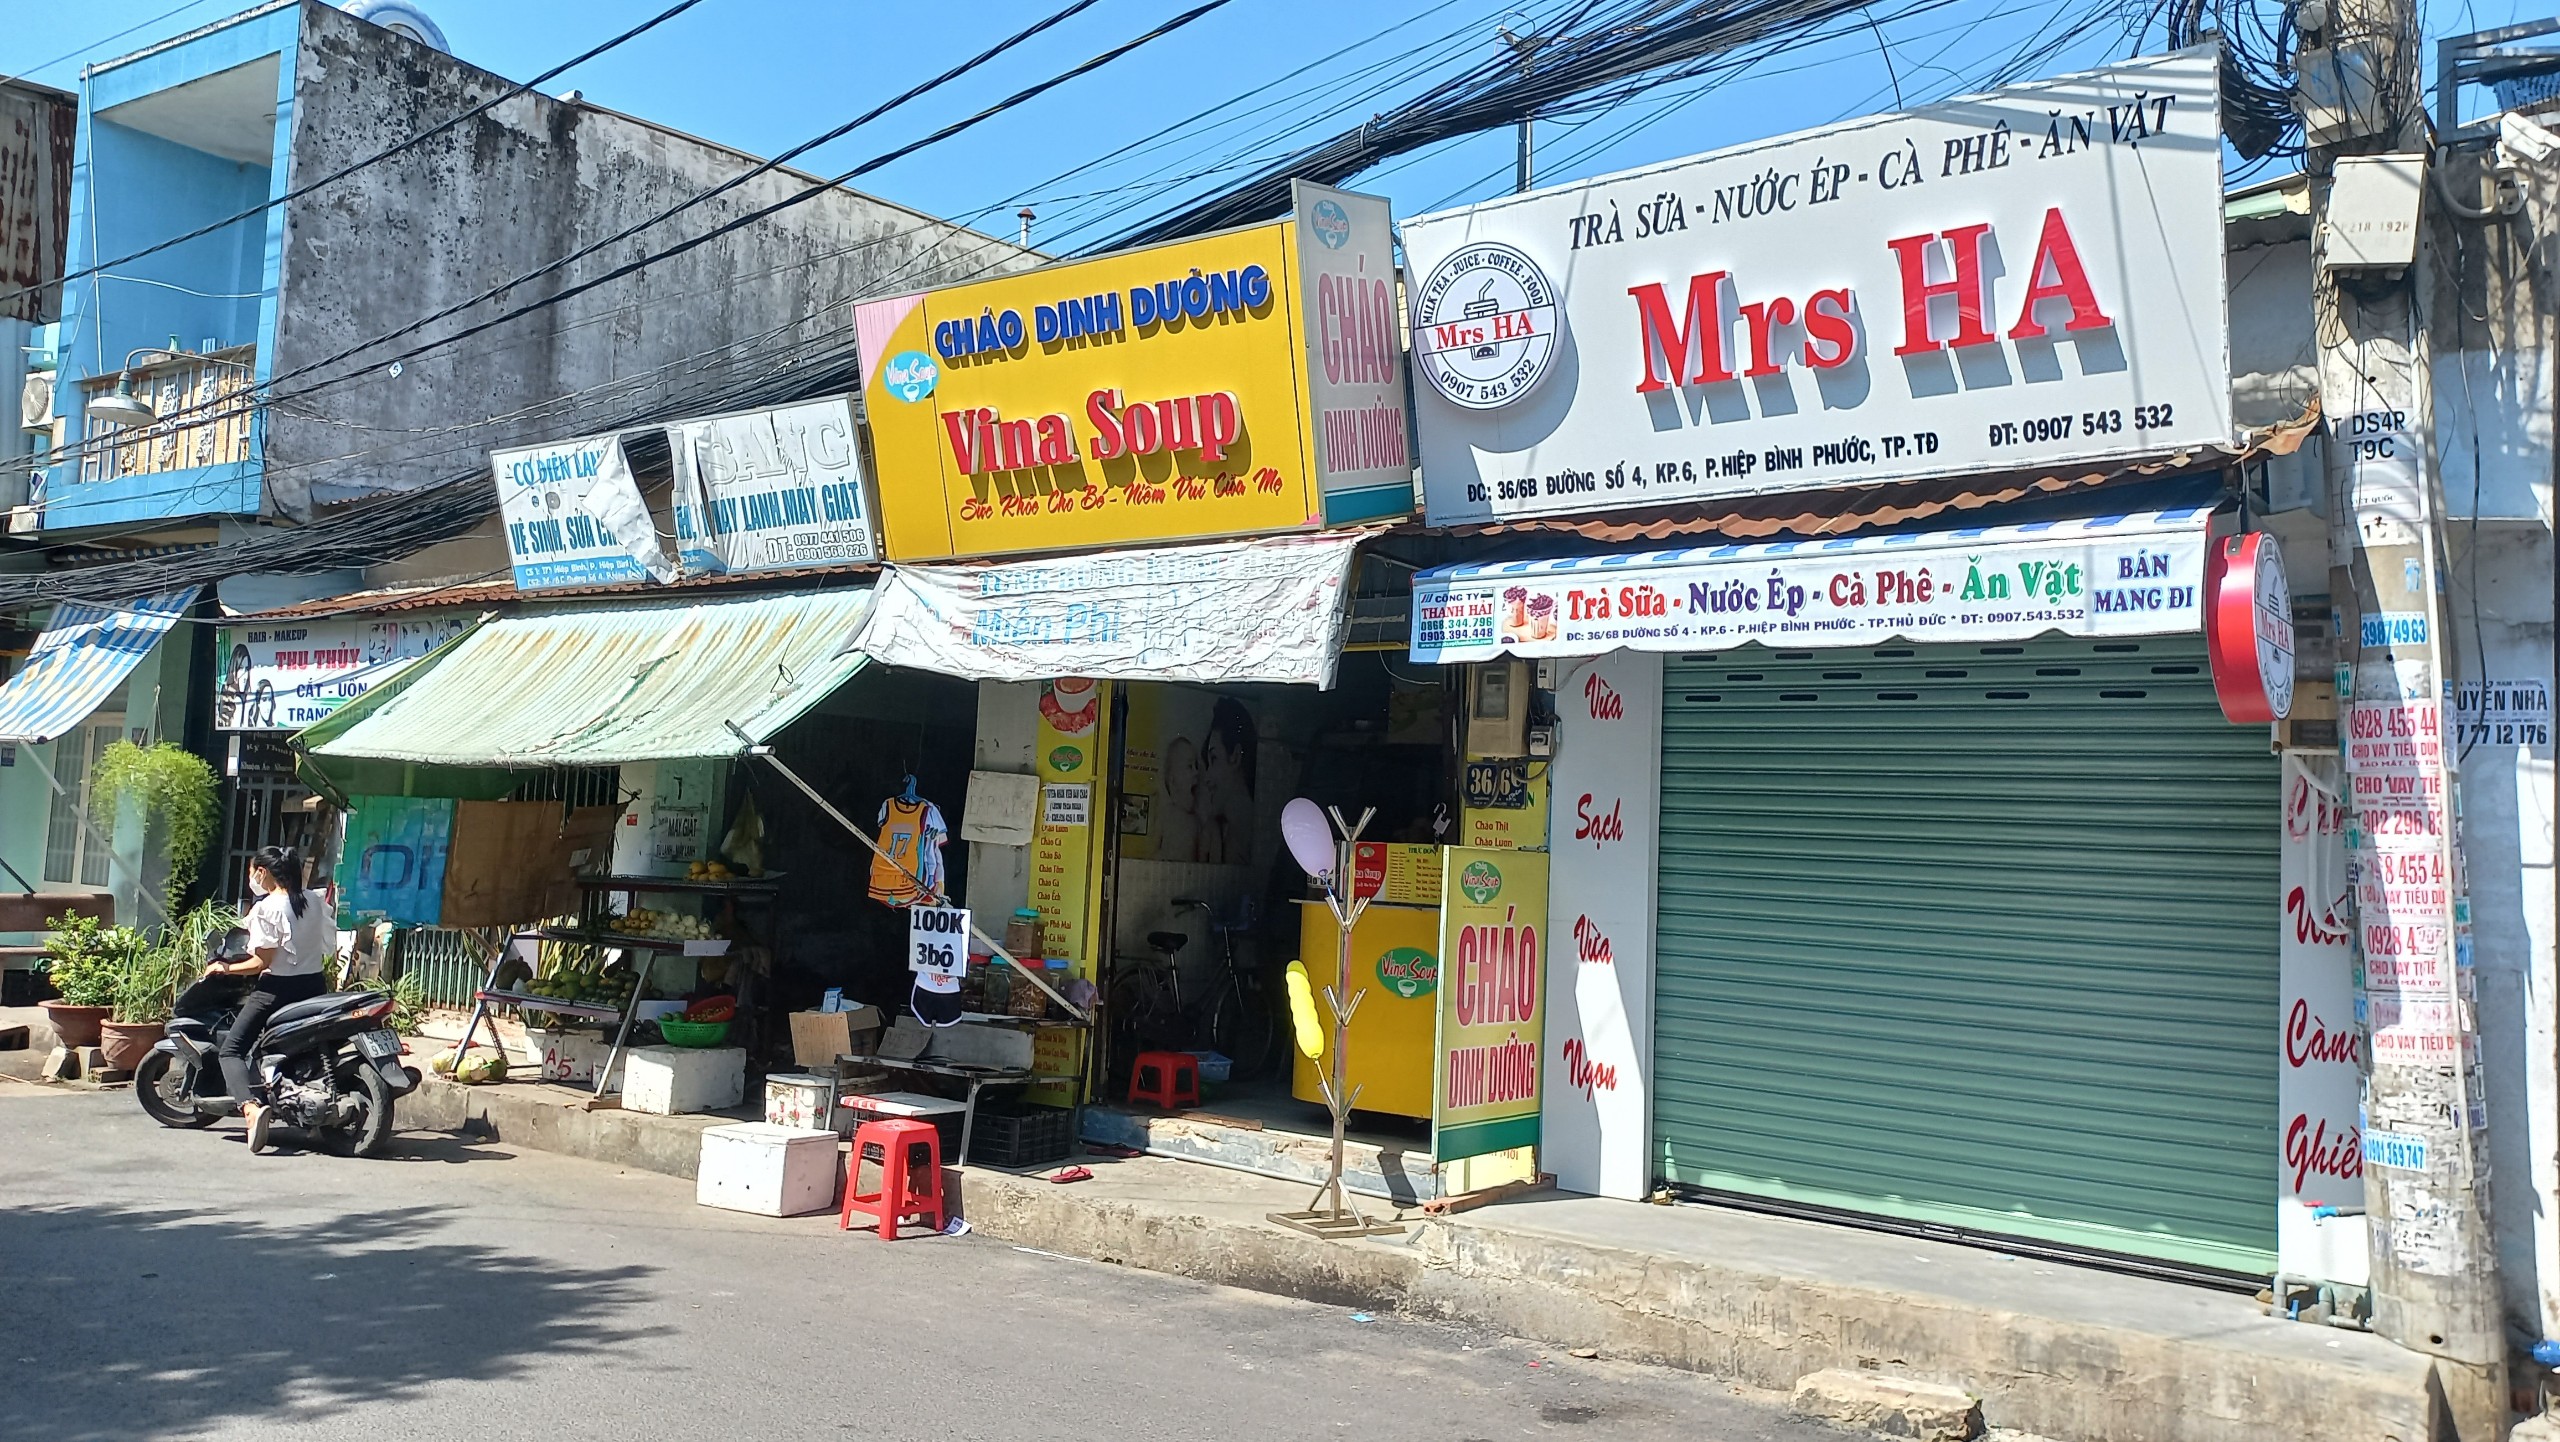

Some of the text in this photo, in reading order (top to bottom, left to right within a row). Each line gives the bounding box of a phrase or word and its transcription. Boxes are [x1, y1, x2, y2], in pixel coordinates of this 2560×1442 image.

[1569, 91, 2176, 250] TRÀ SỮA NƯỚC ÉP CÀ PHÊ ĂN VẶT
[1423, 252, 1544, 324] MILK TEA JUICE COFFEE FOOD
[1627, 207, 2115, 393] Mrs HA
[934, 264, 1270, 359] CHÁO DINH DƯỠNG
[1318, 254, 1395, 386] CHÁO
[1434, 312, 1535, 350] Mrs HA
[884, 358, 938, 386] Vina Soup
[1440, 358, 1536, 400] 0907 543 532
[941, 387, 1239, 477] Vina Soup
[1324, 394, 1405, 474] DINH DƯỠNG
[1989, 403, 2173, 448] ĐT: 0907 543 532
[2352, 411, 2405, 436] DS4R
[2345, 437, 2395, 462] T9C
[1467, 483, 1492, 503] ĐC:
[1497, 475, 1538, 500] 36/6B
[1546, 466, 1596, 496] ĐƯỜNG
[1604, 459, 1625, 489] SỐ
[1632, 465, 1647, 489] 4,
[1764, 443, 1803, 473] BÌNH
[1813, 434, 1876, 467] PHƯỚC,
[821, 476, 862, 528] GIẶT
[1047, 490, 1074, 515] Cho
[1081, 483, 1107, 512] Bé
[1172, 475, 1207, 502] Vui
[1252, 467, 1284, 498] Mẹ
[793, 532, 818, 546] 0977
[820, 530, 841, 545] 441
[842, 528, 865, 543] 506
[796, 543, 868, 561] 0901 568 226
[2119, 549, 2170, 580] BÁN
[1434, 592, 1479, 604] CÔNG TY
[1567, 554, 2084, 622] Trà Sữa Nước Ép Cà Phê Ăn Vặt
[2093, 587, 2194, 614] MANG ĐI
[1420, 616, 1492, 631] 0868.344.796
[1421, 600, 1493, 620] THANH HẢI
[1567, 608, 2085, 642] ĐC: 36/6B ĐƯỜNG SỐ 4 KP.6 P.HIỆP BÌNH PHƯỚC TP.THỦ ĐỨC ĐT: 0907.543.532
[247, 628, 308, 643] HAIR MAKEUP
[1420, 628, 1493, 642] 0903.394.448
[2260, 609, 2290, 650] Mrs HA
[275, 641, 361, 671] THU THỦY
[296, 678, 324, 698] CẮT
[1584, 672, 1624, 721] Vừa
[2350, 706, 2416, 739] 0928 455
[2496, 724, 2513, 745] 12
[2520, 724, 2547, 745] 176
[2352, 743, 2391, 759] CHO VAY
[2355, 776, 2415, 794] CHO VAY
[1475, 820, 1493, 830] Cháo
[1575, 792, 1625, 850] Sạch
[2394, 810, 2423, 835] 296
[1475, 836, 1493, 847] Cháo
[1463, 871, 1500, 889] Vina Soup
[2399, 854, 2427, 885] 455
[913, 909, 966, 935] 100K
[1573, 913, 1613, 965] Vừa
[2367, 925, 2402, 955] 0928
[916, 942, 954, 973] 3bộ
[1382, 953, 1406, 979] Vina
[1456, 905, 1537, 1028] CHÁO
[2369, 960, 2410, 976] CHO VAY
[2375, 1033, 2416, 1050] CHO VAY
[545, 1048, 572, 1079] A 5
[1448, 1031, 1537, 1110] DINH DƯỠNG
[1563, 1038, 1618, 1103] Ngon
[2286, 1113, 2364, 1195] Ghiề
[2406, 1144, 2424, 1169] 747
